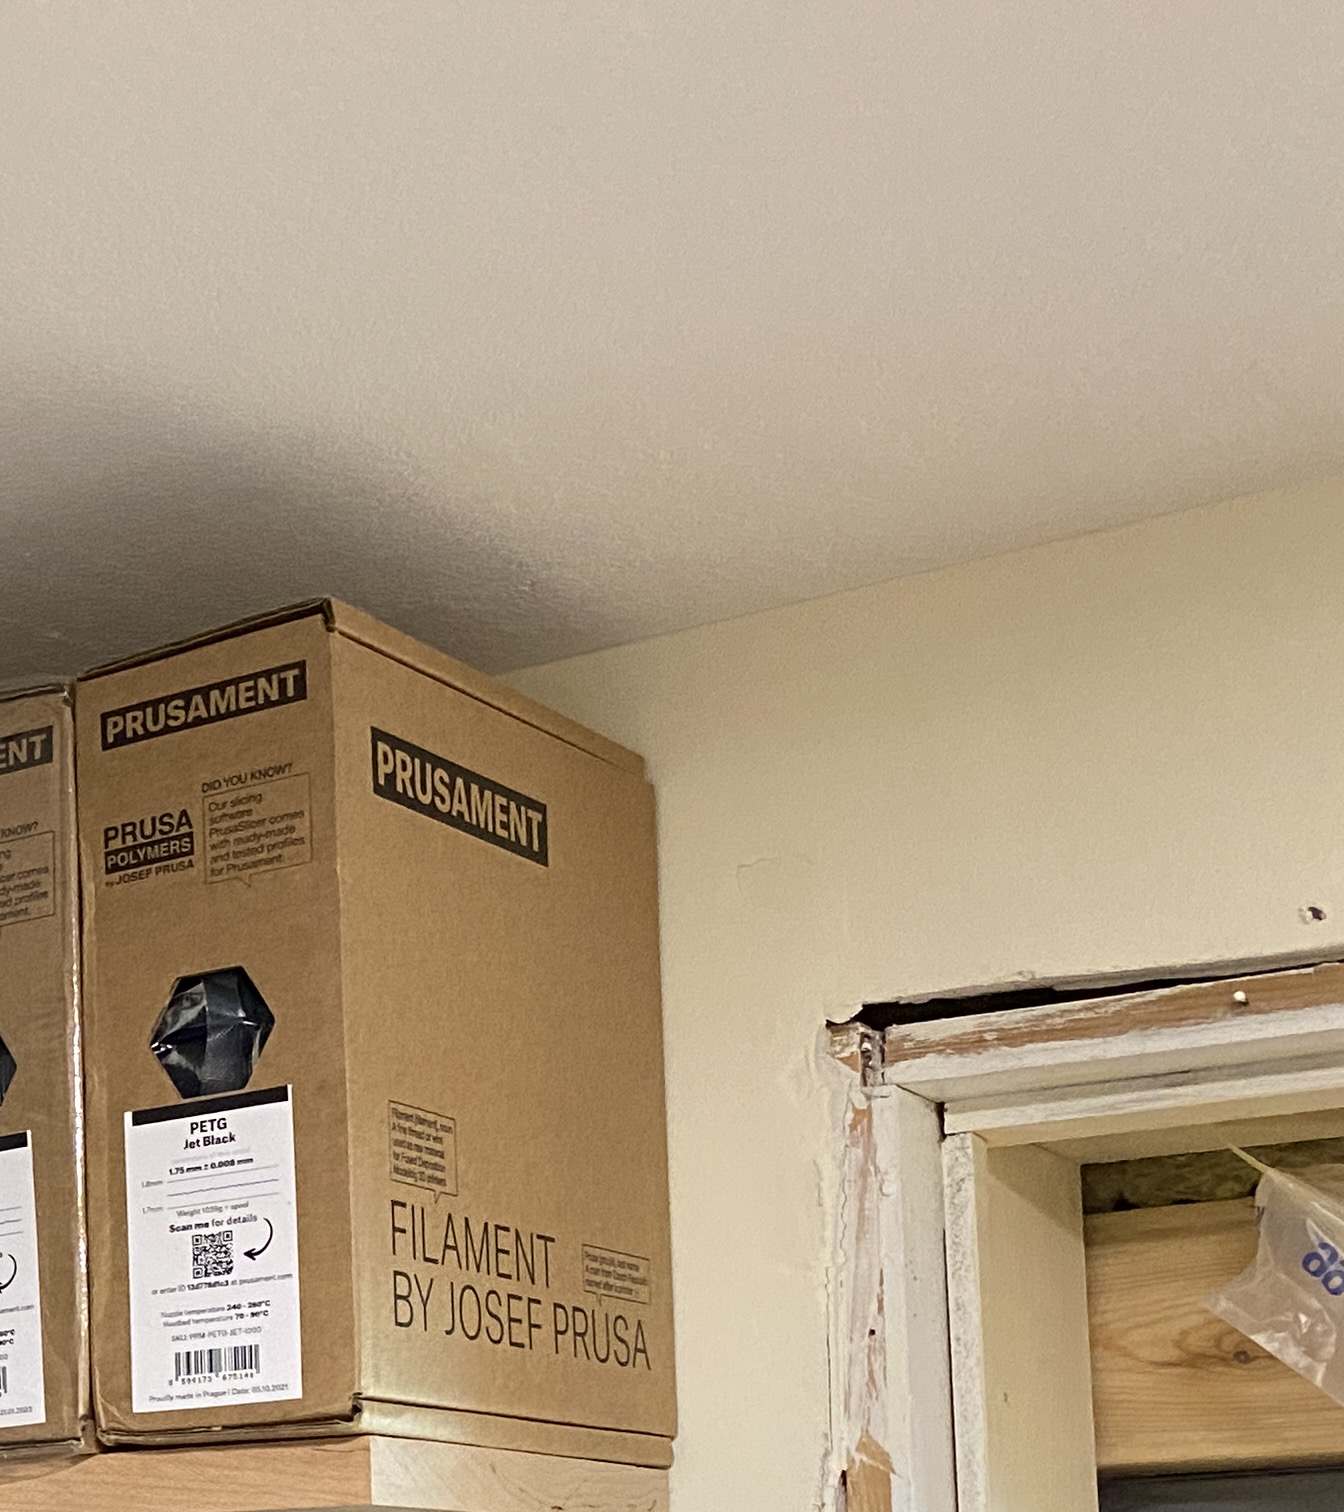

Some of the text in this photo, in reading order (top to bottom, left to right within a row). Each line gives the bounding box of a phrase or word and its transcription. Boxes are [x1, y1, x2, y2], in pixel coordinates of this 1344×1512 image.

[106, 669, 299, 743] PRUSAMENT
[202, 762, 293, 794] DID YOU KNOW?
[209, 793, 262, 812] Our slicing
[377, 741, 543, 852] PRUSAMENT
[1, 821, 38, 838] KNOW?
[103, 809, 193, 849] PRUSA
[209, 809, 252, 826] software
[209, 810, 304, 838] PrusaSlicer comes
[210, 825, 296, 851] with ready-made
[210, 837, 305, 864] and tested profiles
[107, 838, 191, 869] POLYMERS
[116, 859, 194, 886] JOSEF PRUSA
[211, 867, 224, 877] for
[190, 1118, 228, 1135] PETG
[184, 1132, 237, 1150] Jet Black
[169, 1167, 185, 1175] 1.75
[169, 1213, 258, 1233] Scan me for details
[390, 1199, 556, 1288] FILAMENT
[393, 1270, 652, 1370] BY JOSEF PRUSA
